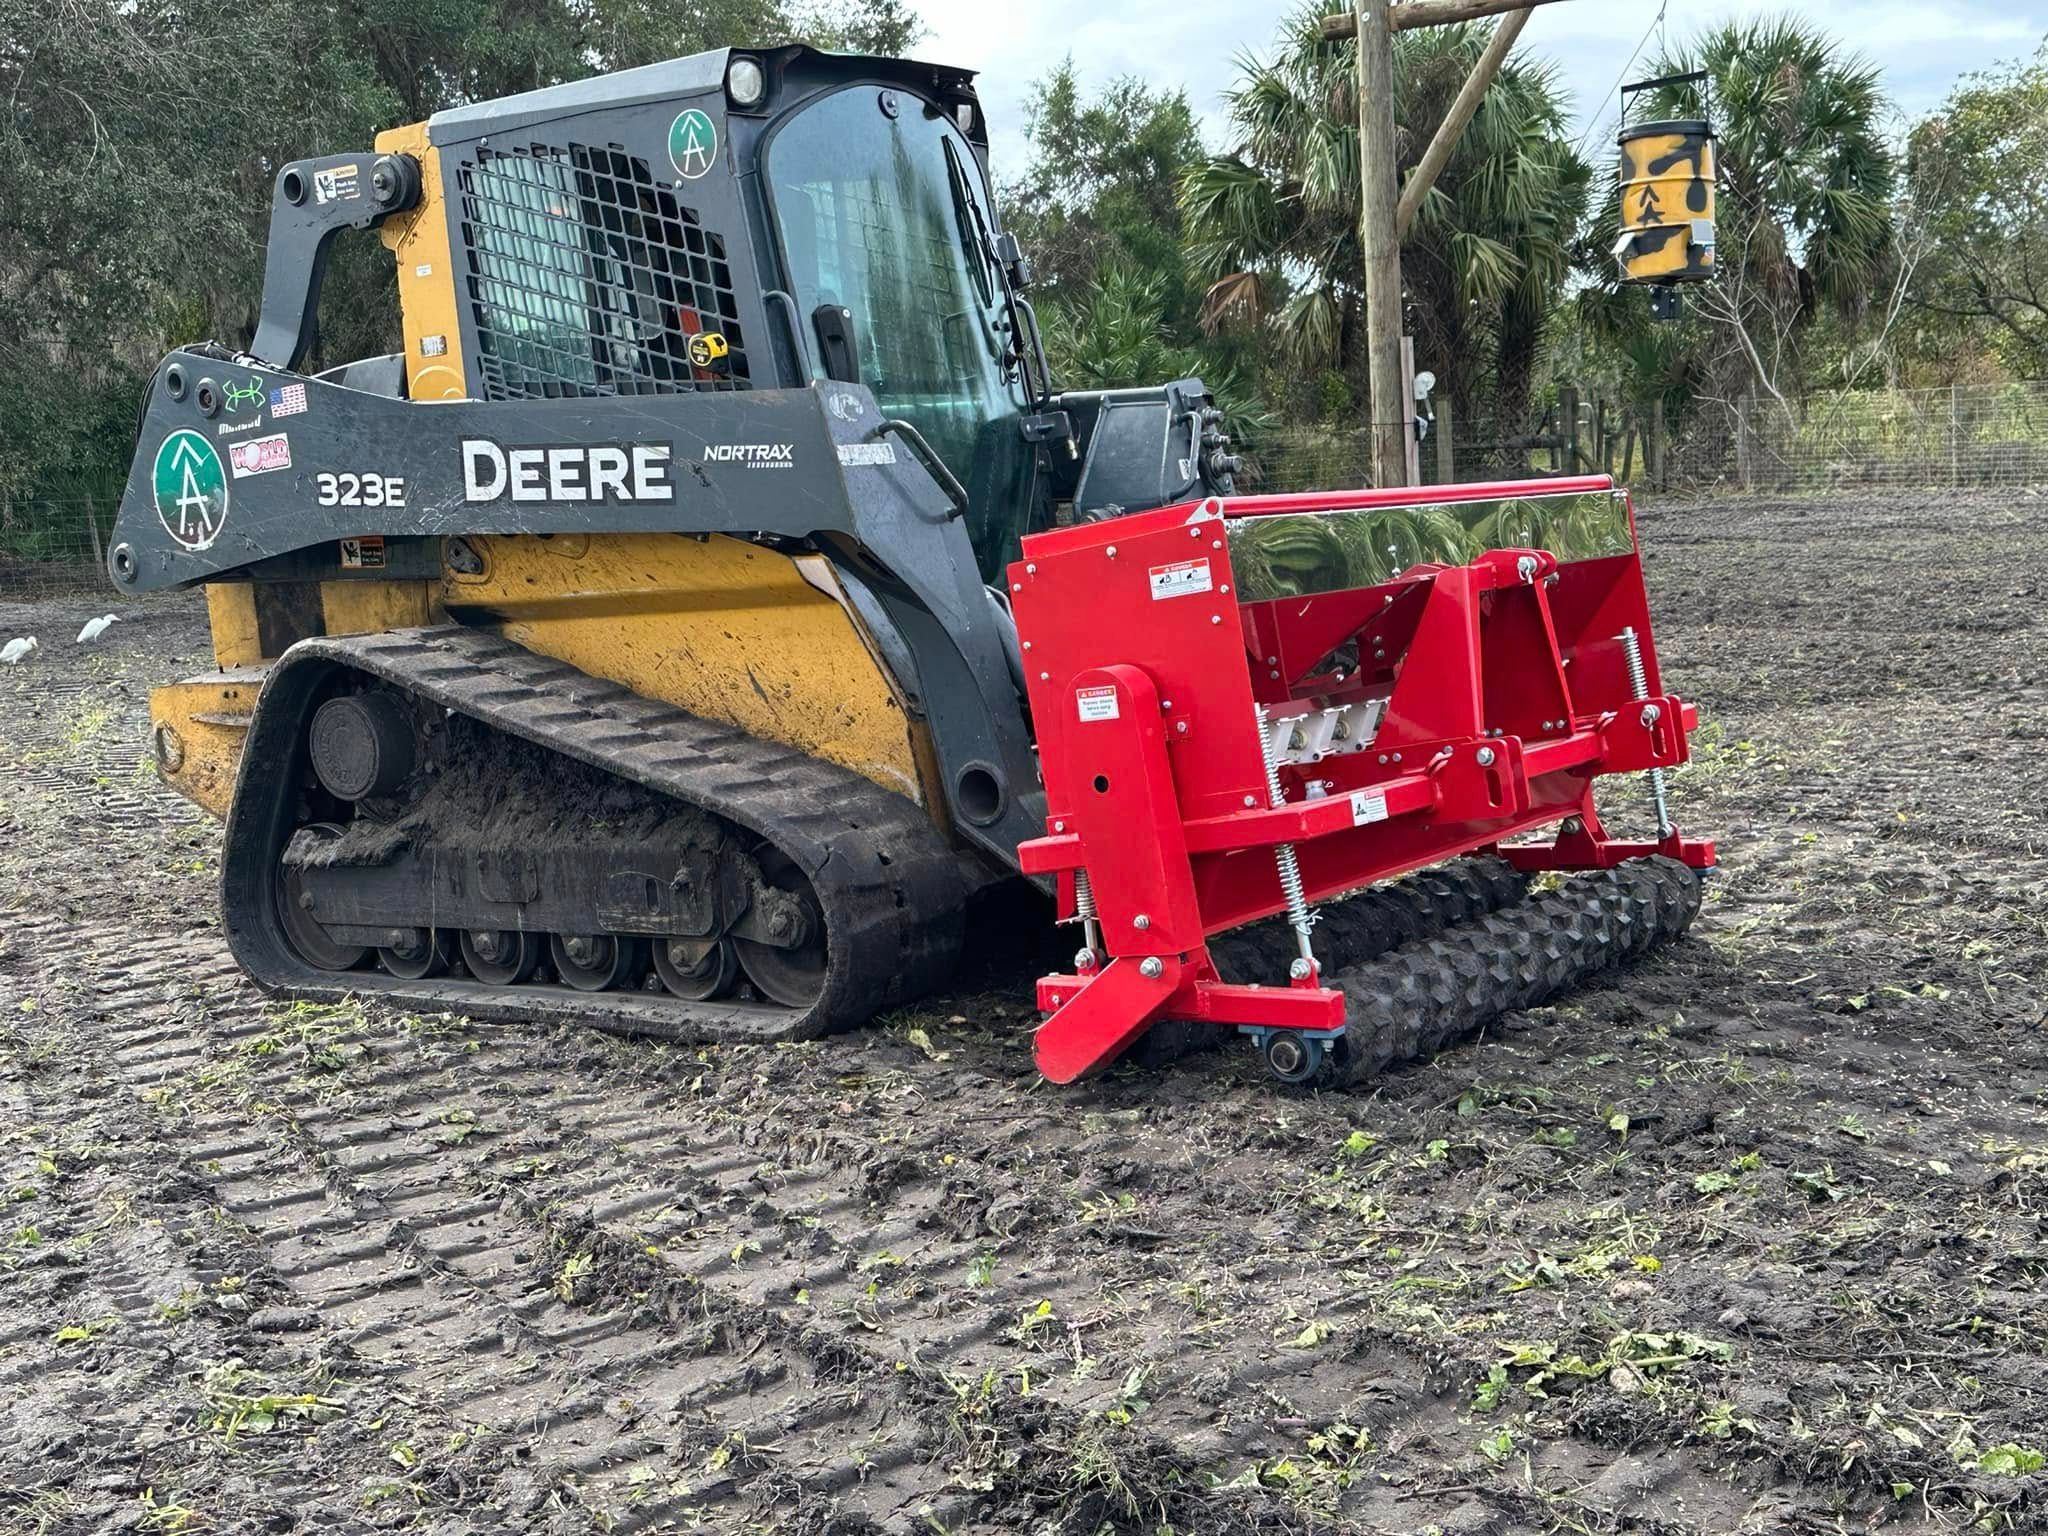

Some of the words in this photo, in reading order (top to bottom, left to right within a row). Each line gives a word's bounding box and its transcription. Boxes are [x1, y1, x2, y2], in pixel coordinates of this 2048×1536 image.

[703, 443, 793, 461] NORTRAX
[462, 440, 673, 502] DEERE
[318, 473, 405, 507] 323E
